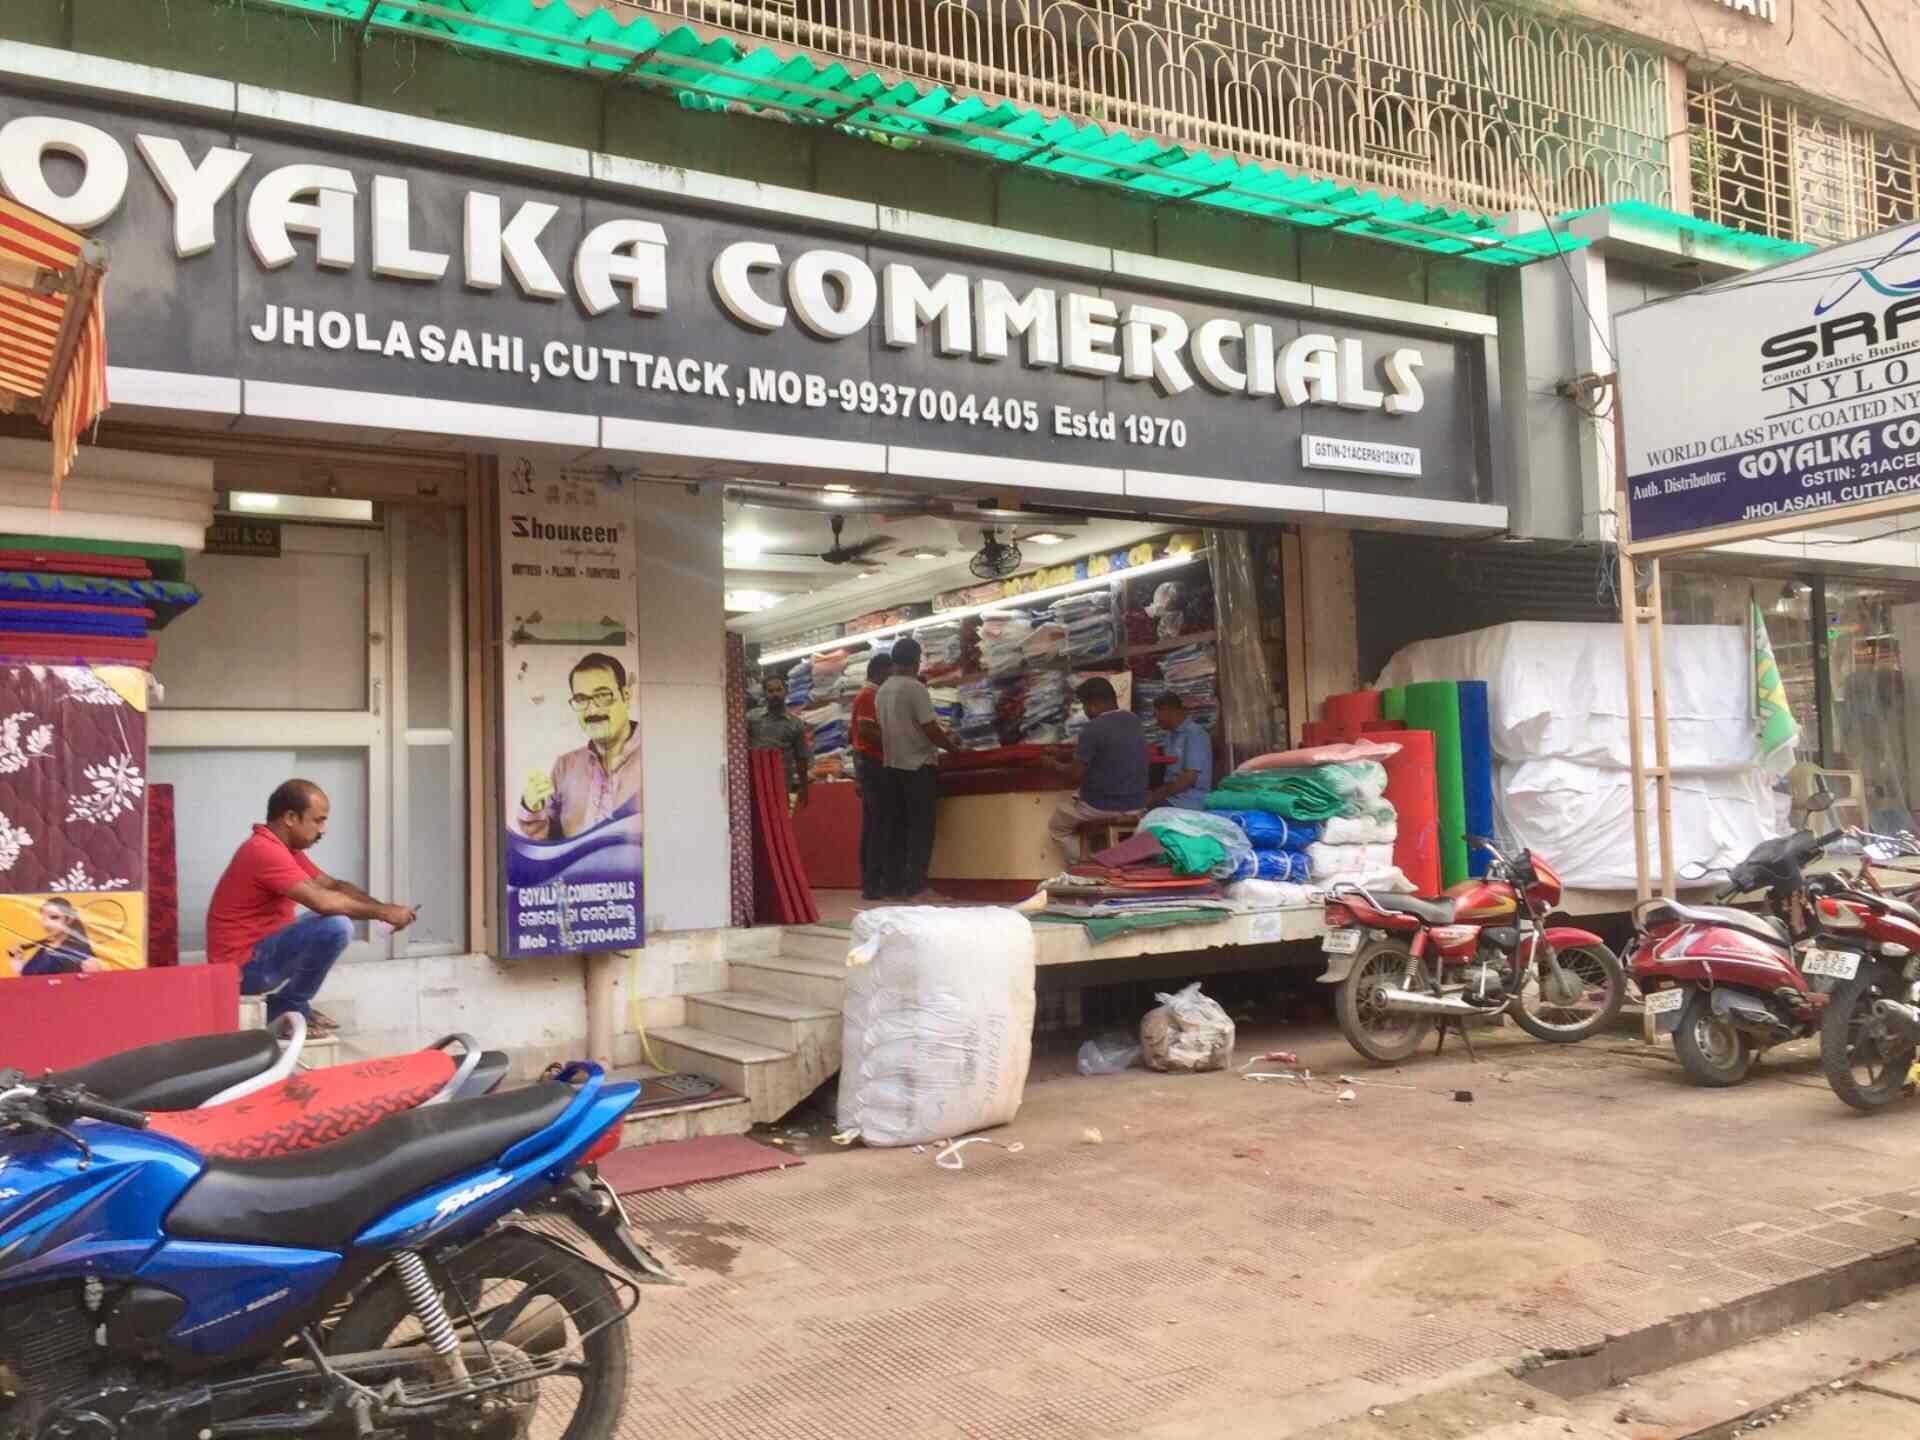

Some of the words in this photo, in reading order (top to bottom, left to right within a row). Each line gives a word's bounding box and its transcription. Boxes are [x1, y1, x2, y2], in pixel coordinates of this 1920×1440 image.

[0, 115, 670, 317] OYALKA
[712, 241, 1426, 415] COMMERCIALS
[1762, 364, 1811, 386] Coated
[1816, 352, 1863, 371] Fabric
[1053, 405, 1116, 442] Estd
[1123, 413, 1188, 449] 1970
[1647, 440, 1707, 467] WORLD
[1711, 427, 1764, 455] CLASS
[1769, 418, 1804, 443] PVC
[1808, 398, 1888, 432] COATED
[1633, 481, 1662, 500] Auth.
[1664, 471, 1727, 494] Distributor:
[1738, 429, 1872, 479] GOYALKA
[1801, 466, 1856, 489] GSTIN:
[1860, 450, 1920, 478] 21ACE
[511, 514, 618, 544] Shoukeen
[518, 932, 548, 950] Mob
